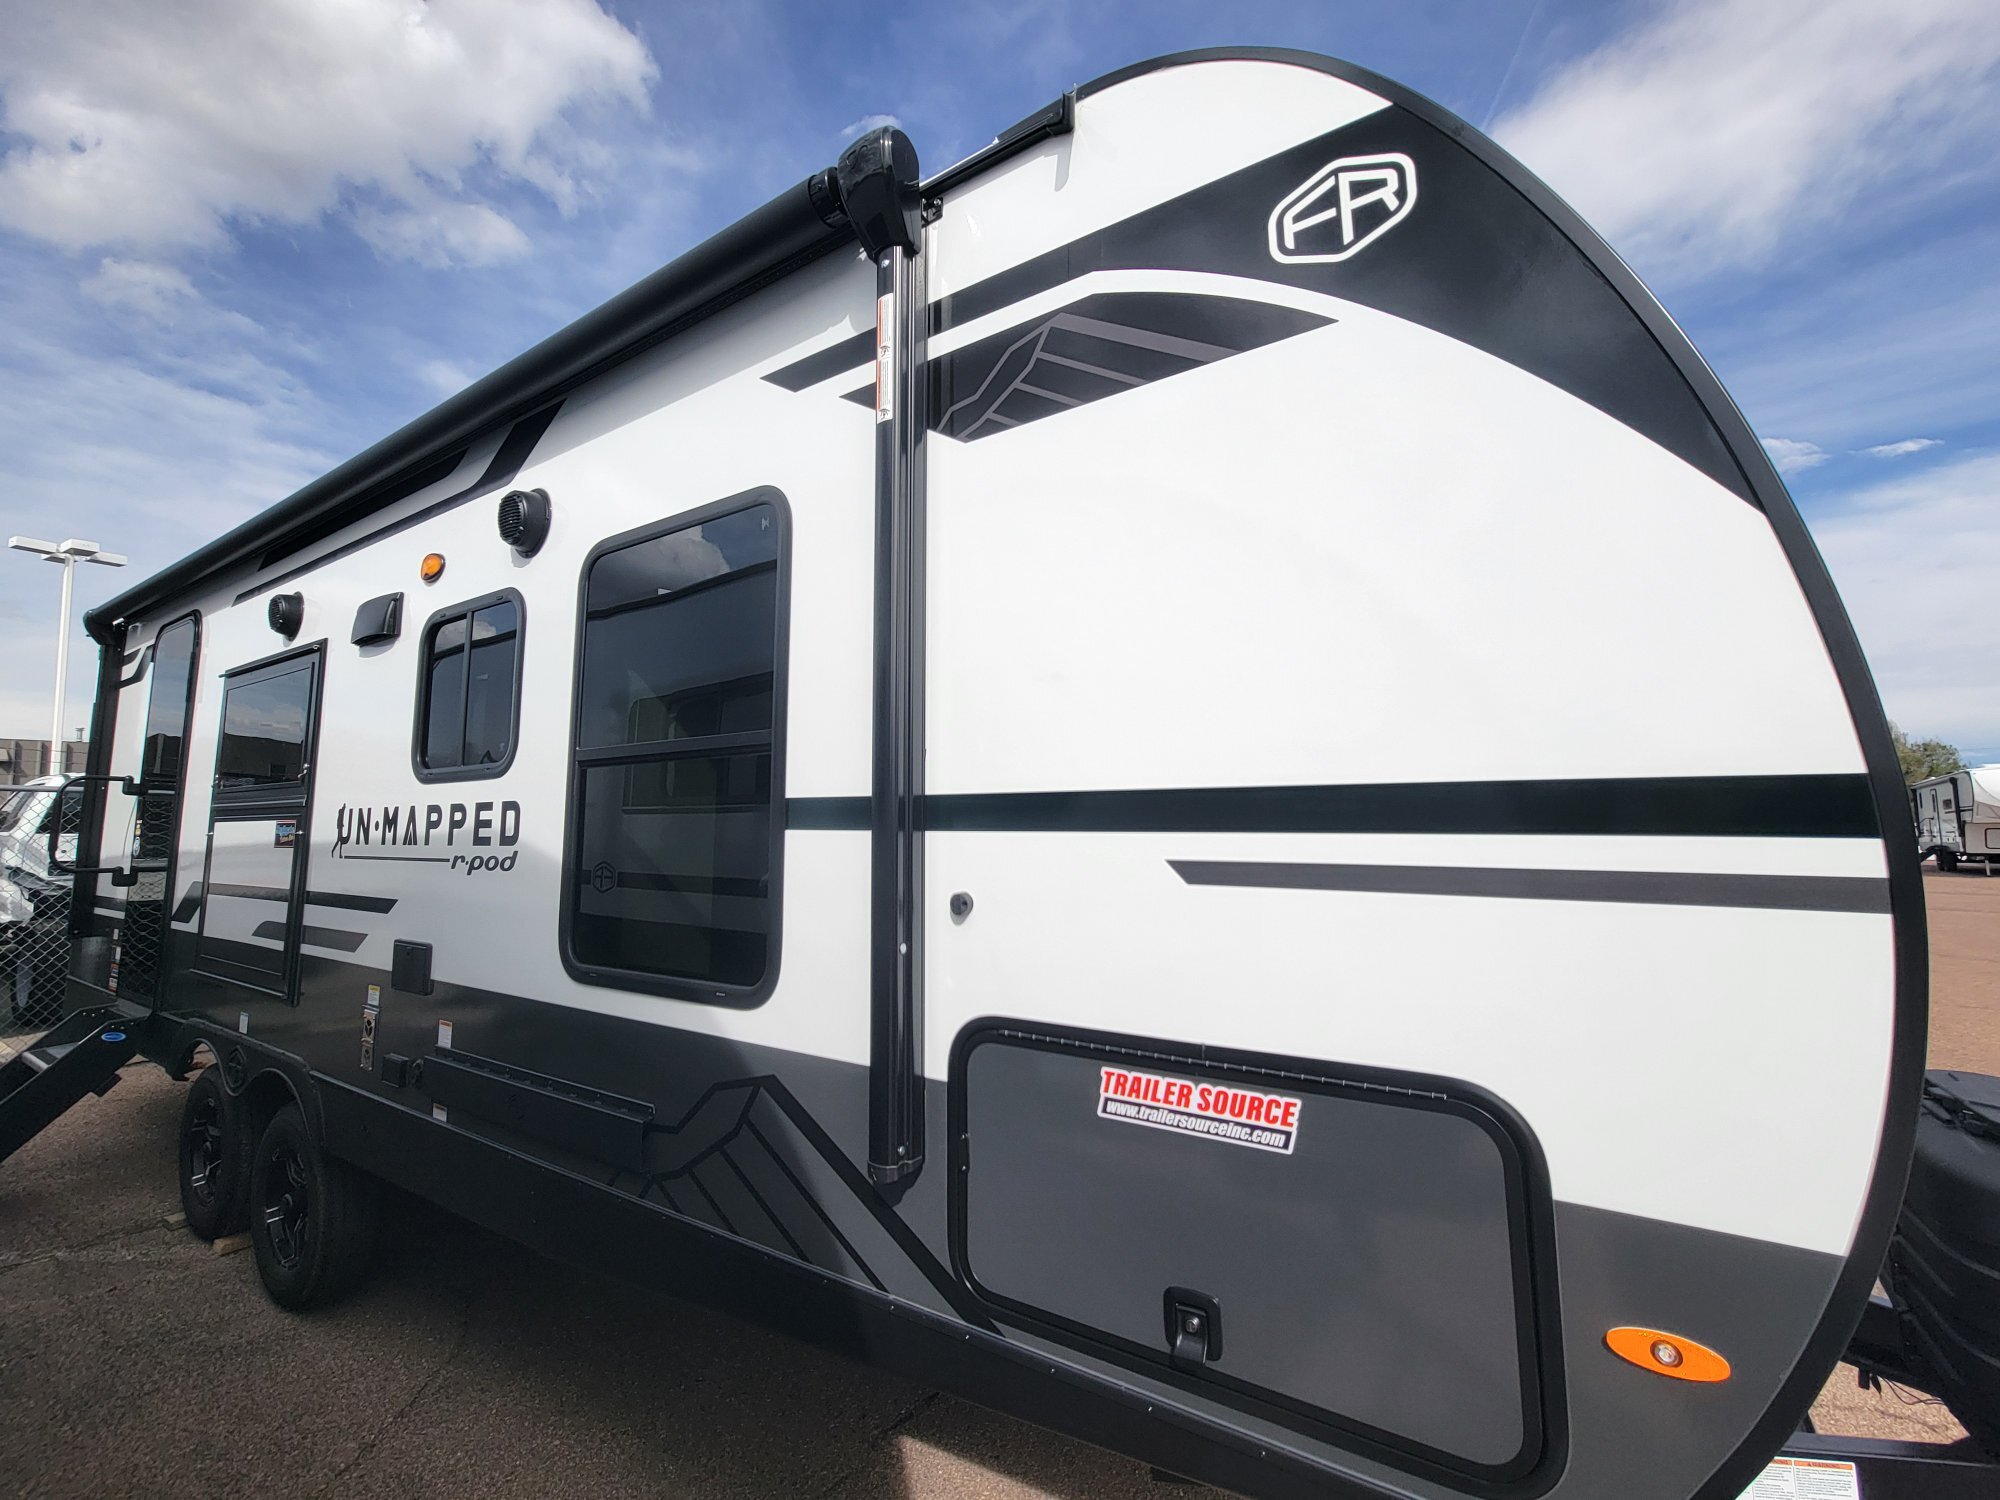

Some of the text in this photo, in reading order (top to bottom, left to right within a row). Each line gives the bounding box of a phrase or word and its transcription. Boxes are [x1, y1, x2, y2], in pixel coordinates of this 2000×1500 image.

[1102, 1071, 1299, 1128] TRAILER SOURCE
[1105, 1099, 1287, 1148] www.trailersourceinc.com
